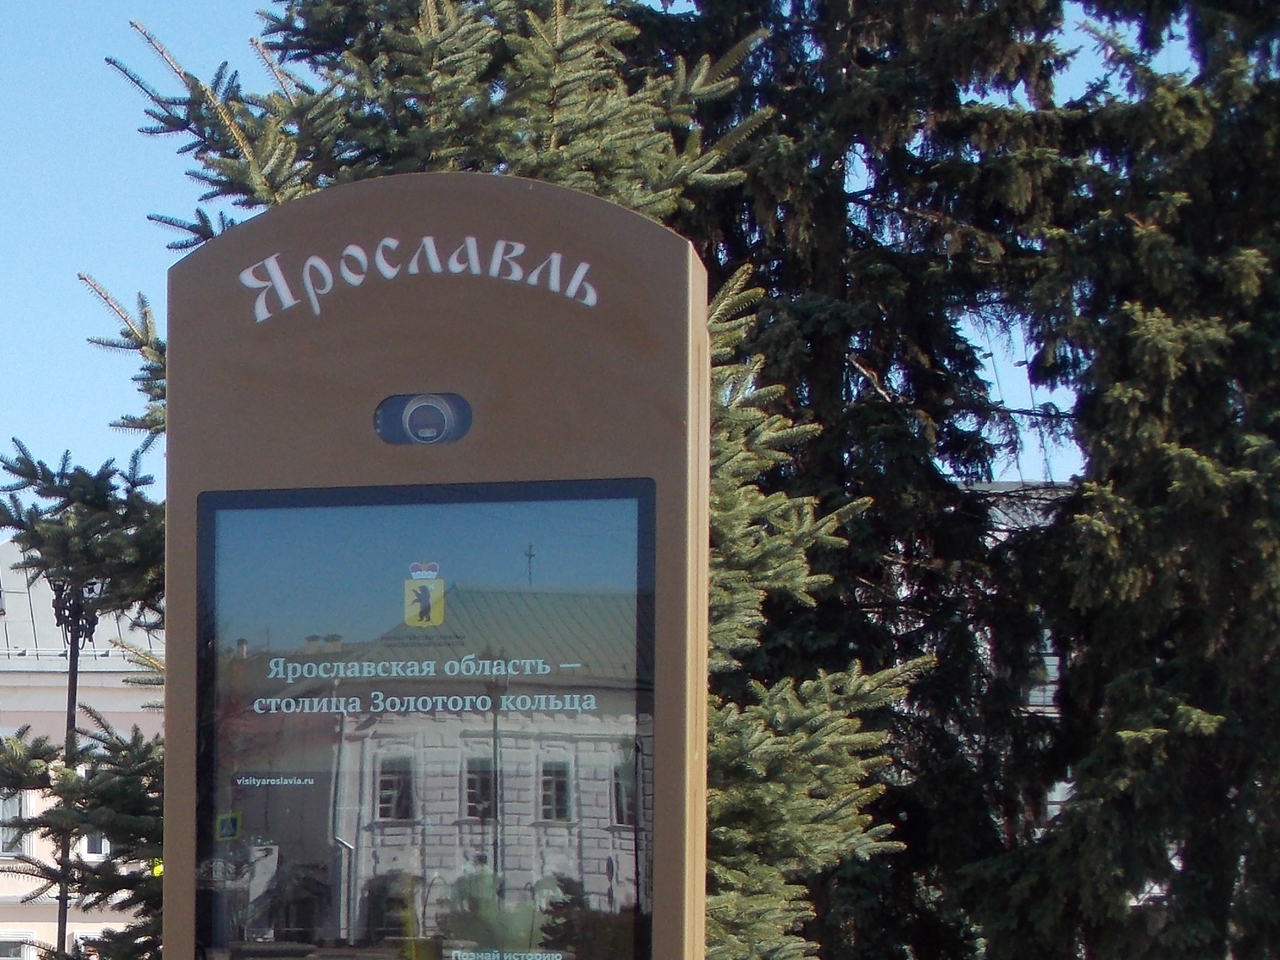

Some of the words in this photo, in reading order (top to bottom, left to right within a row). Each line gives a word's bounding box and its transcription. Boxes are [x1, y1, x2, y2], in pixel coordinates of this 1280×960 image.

[238, 235, 598, 323] Ярославль
[267, 657, 437, 684] Ярославская
[444, 653, 551, 677] область
[253, 696, 362, 717] столица
[370, 691, 492, 714] Золотого
[499, 693, 598, 714] кольца
[236, 776, 314, 787] visityaroslavia.ru
[451, 949, 500, 960] Познай
